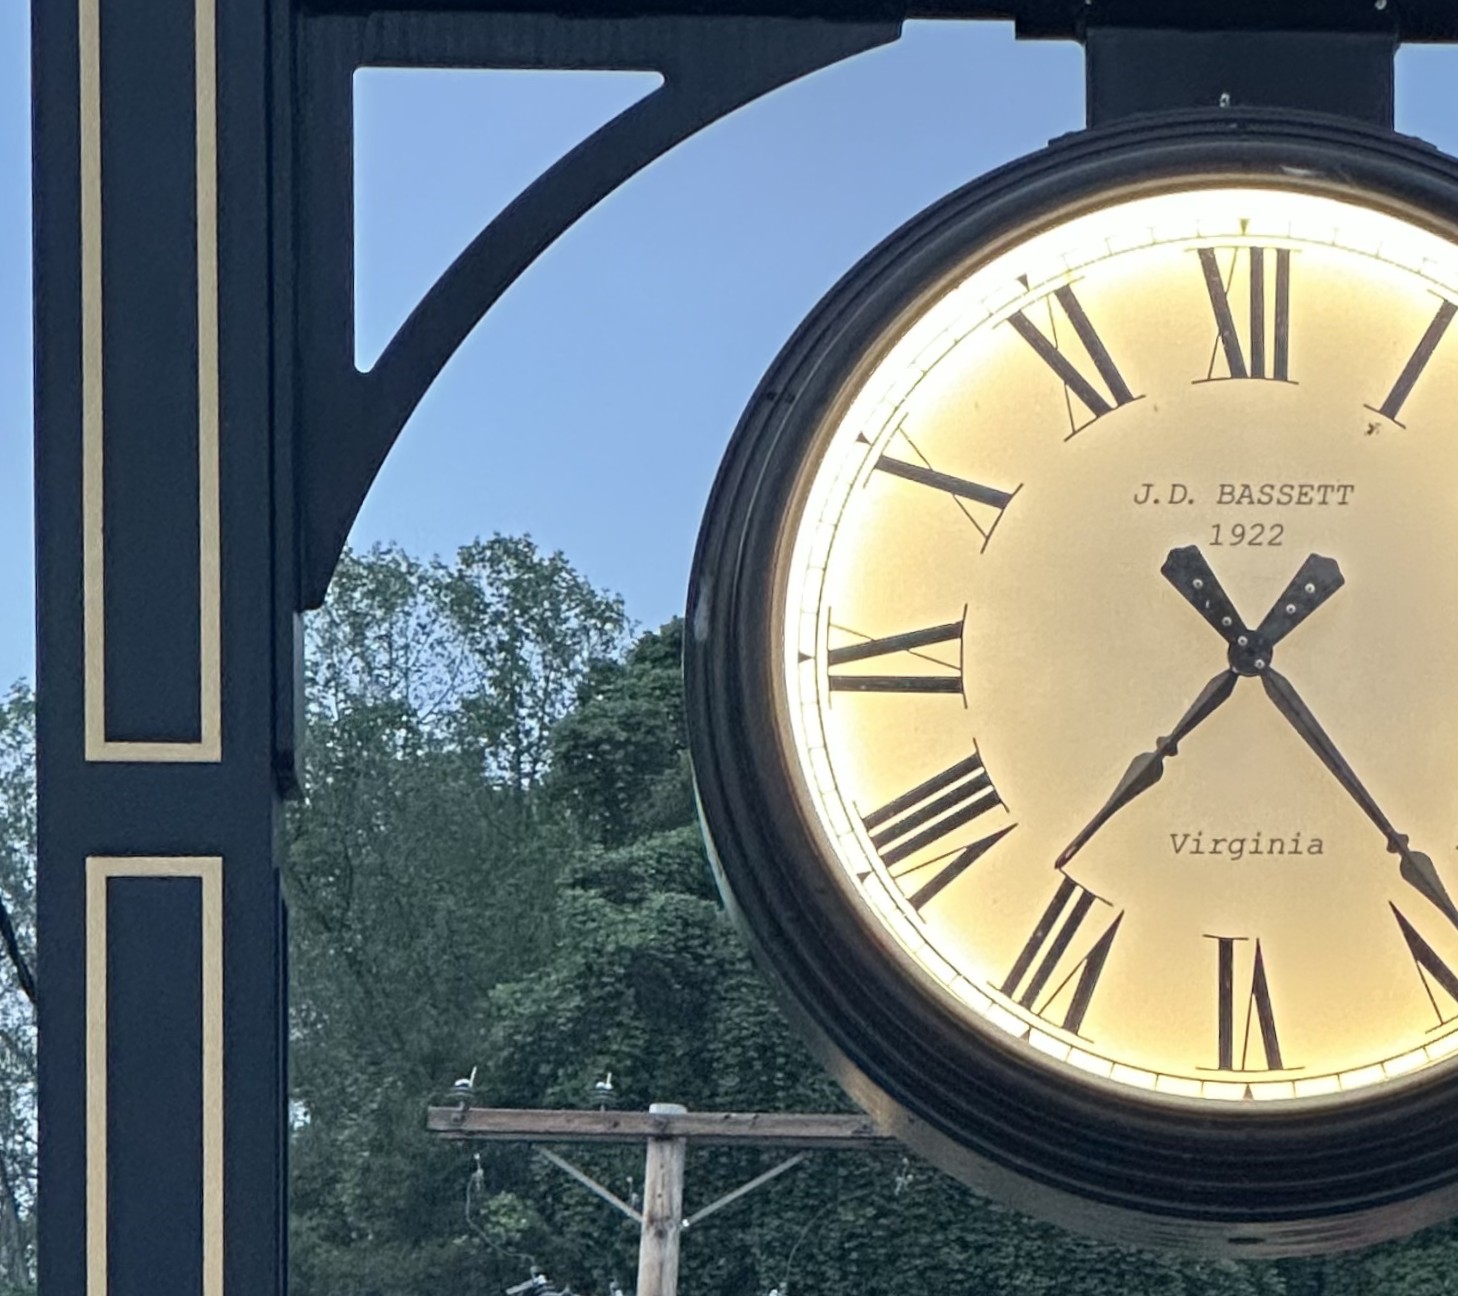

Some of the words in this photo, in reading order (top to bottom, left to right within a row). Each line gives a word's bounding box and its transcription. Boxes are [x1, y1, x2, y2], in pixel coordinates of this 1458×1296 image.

[1133, 483, 1195, 505] J.D.
[1216, 483, 1355, 506] BASSETT
[1208, 522, 1285, 547] 1922
[1169, 830, 1325, 862] Virginia
